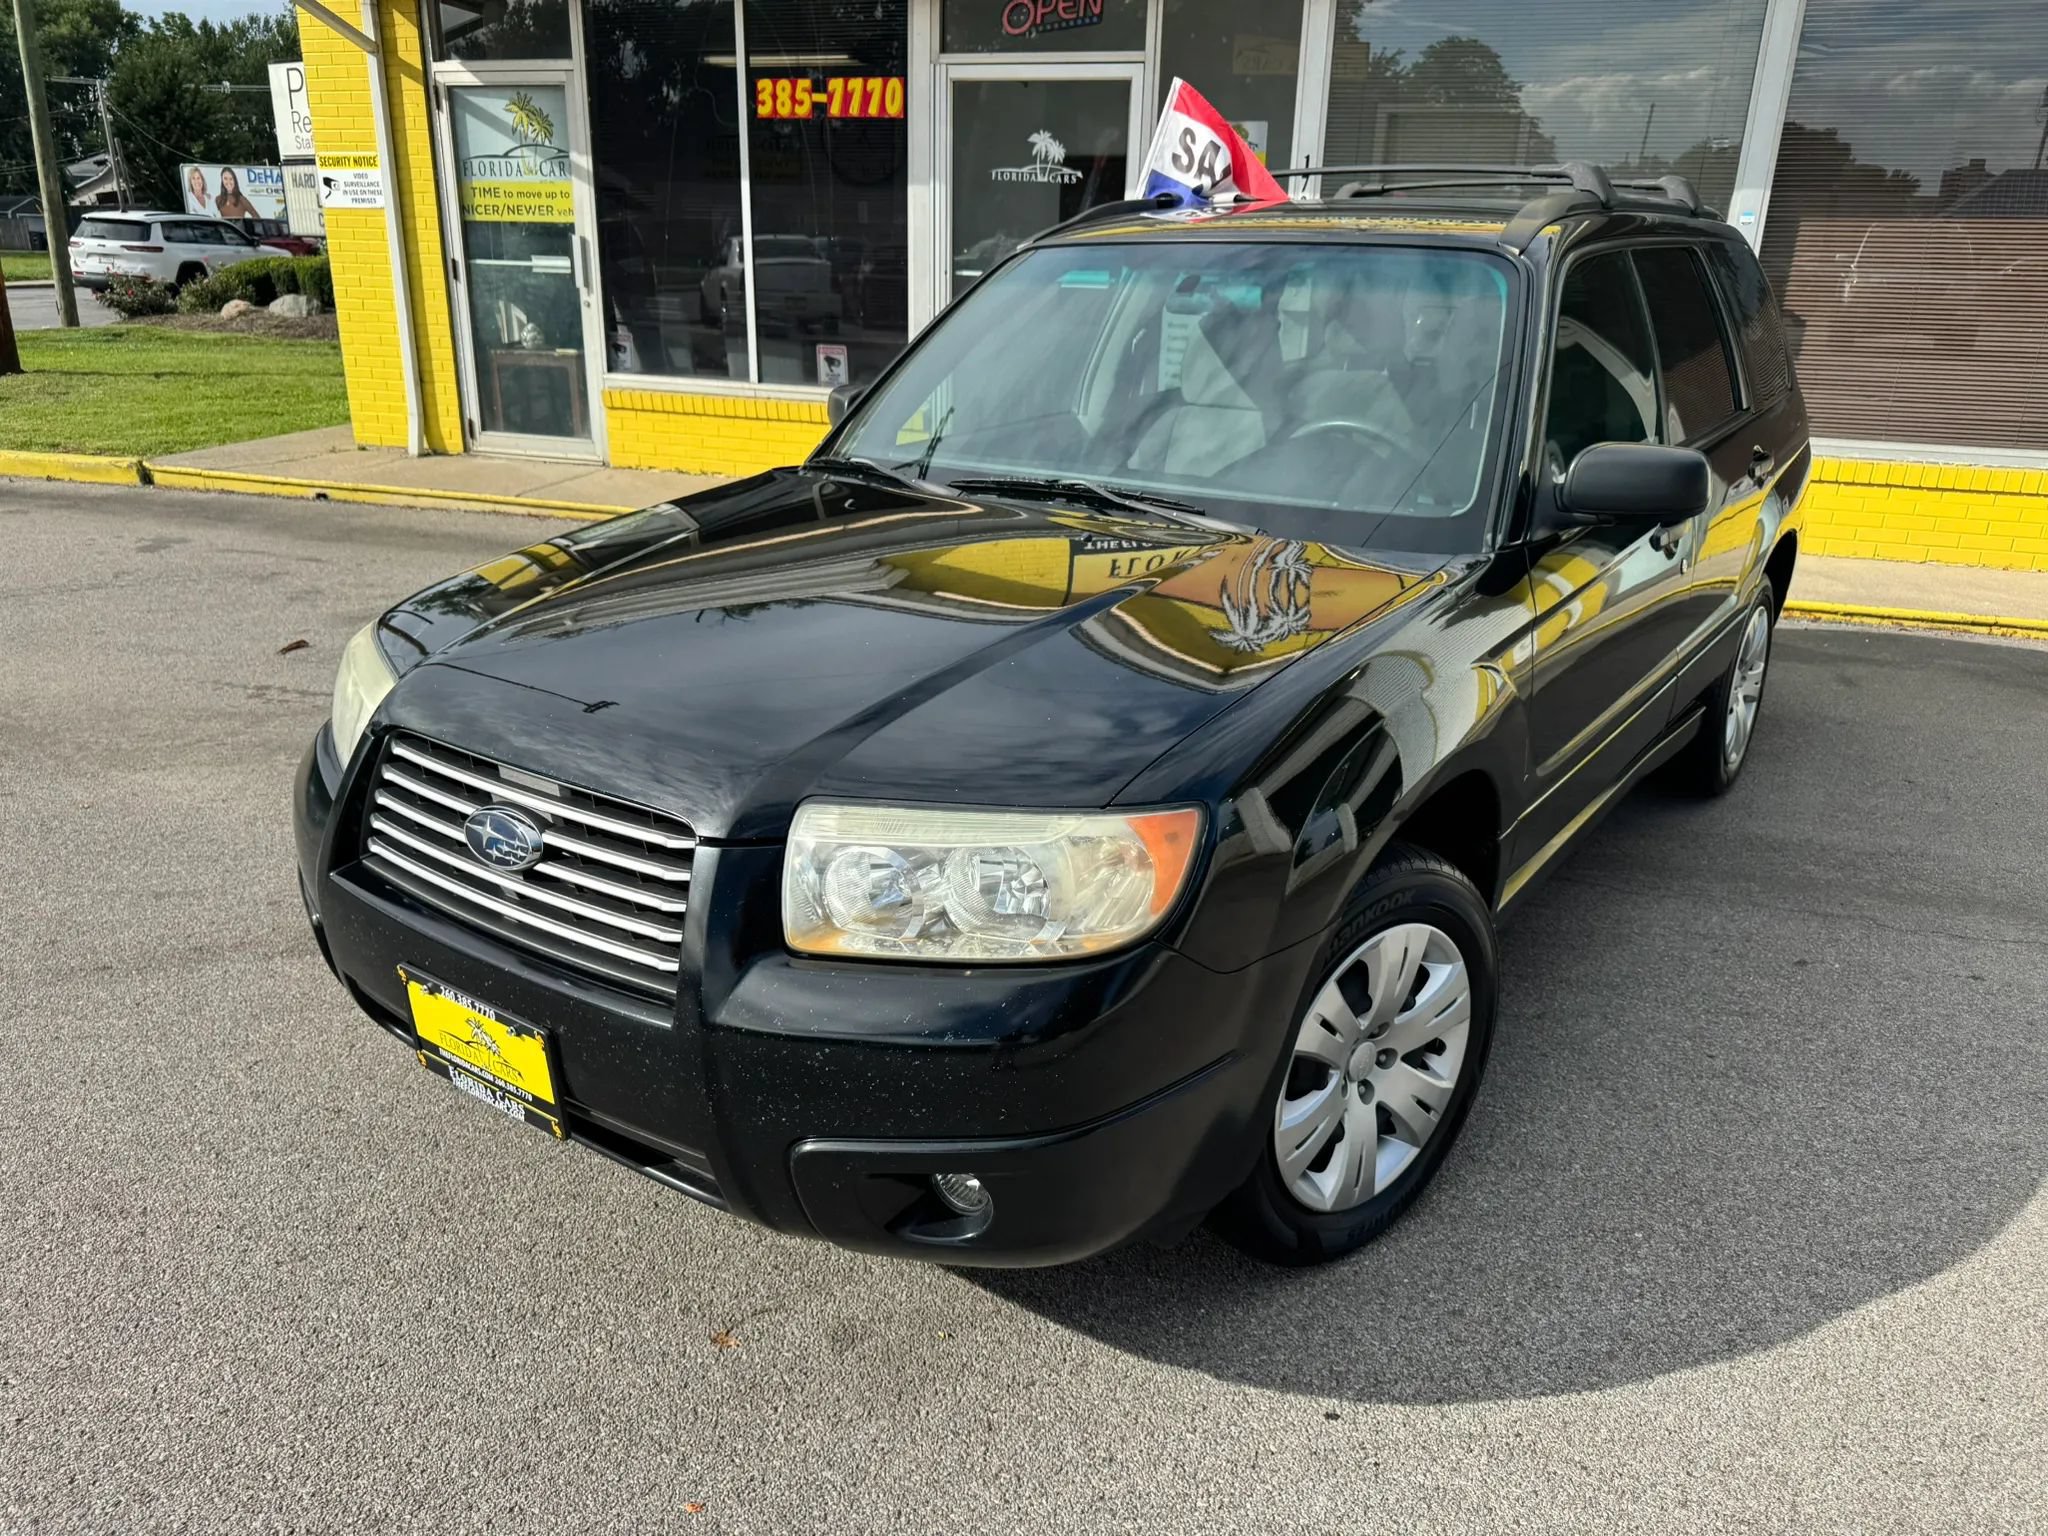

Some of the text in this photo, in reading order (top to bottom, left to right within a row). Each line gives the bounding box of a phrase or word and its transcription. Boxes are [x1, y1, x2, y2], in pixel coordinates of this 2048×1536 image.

[1002, 0, 1102, 35] OPEN
[286, 67, 308, 110] P
[757, 78, 904, 117] 385-7770
[319, 155, 378, 168] SECURITY NOTICE
[463, 160, 572, 177] FLORIDA CAR
[991, 170, 1077, 184] FLORIDA CARS
[470, 187, 570, 200] TIME to move up to
[462, 203, 554, 217] NICER/NEWER
[439, 986, 496, 1021] 260.385.7770
[440, 1032, 520, 1082] FLORIDA CARS
